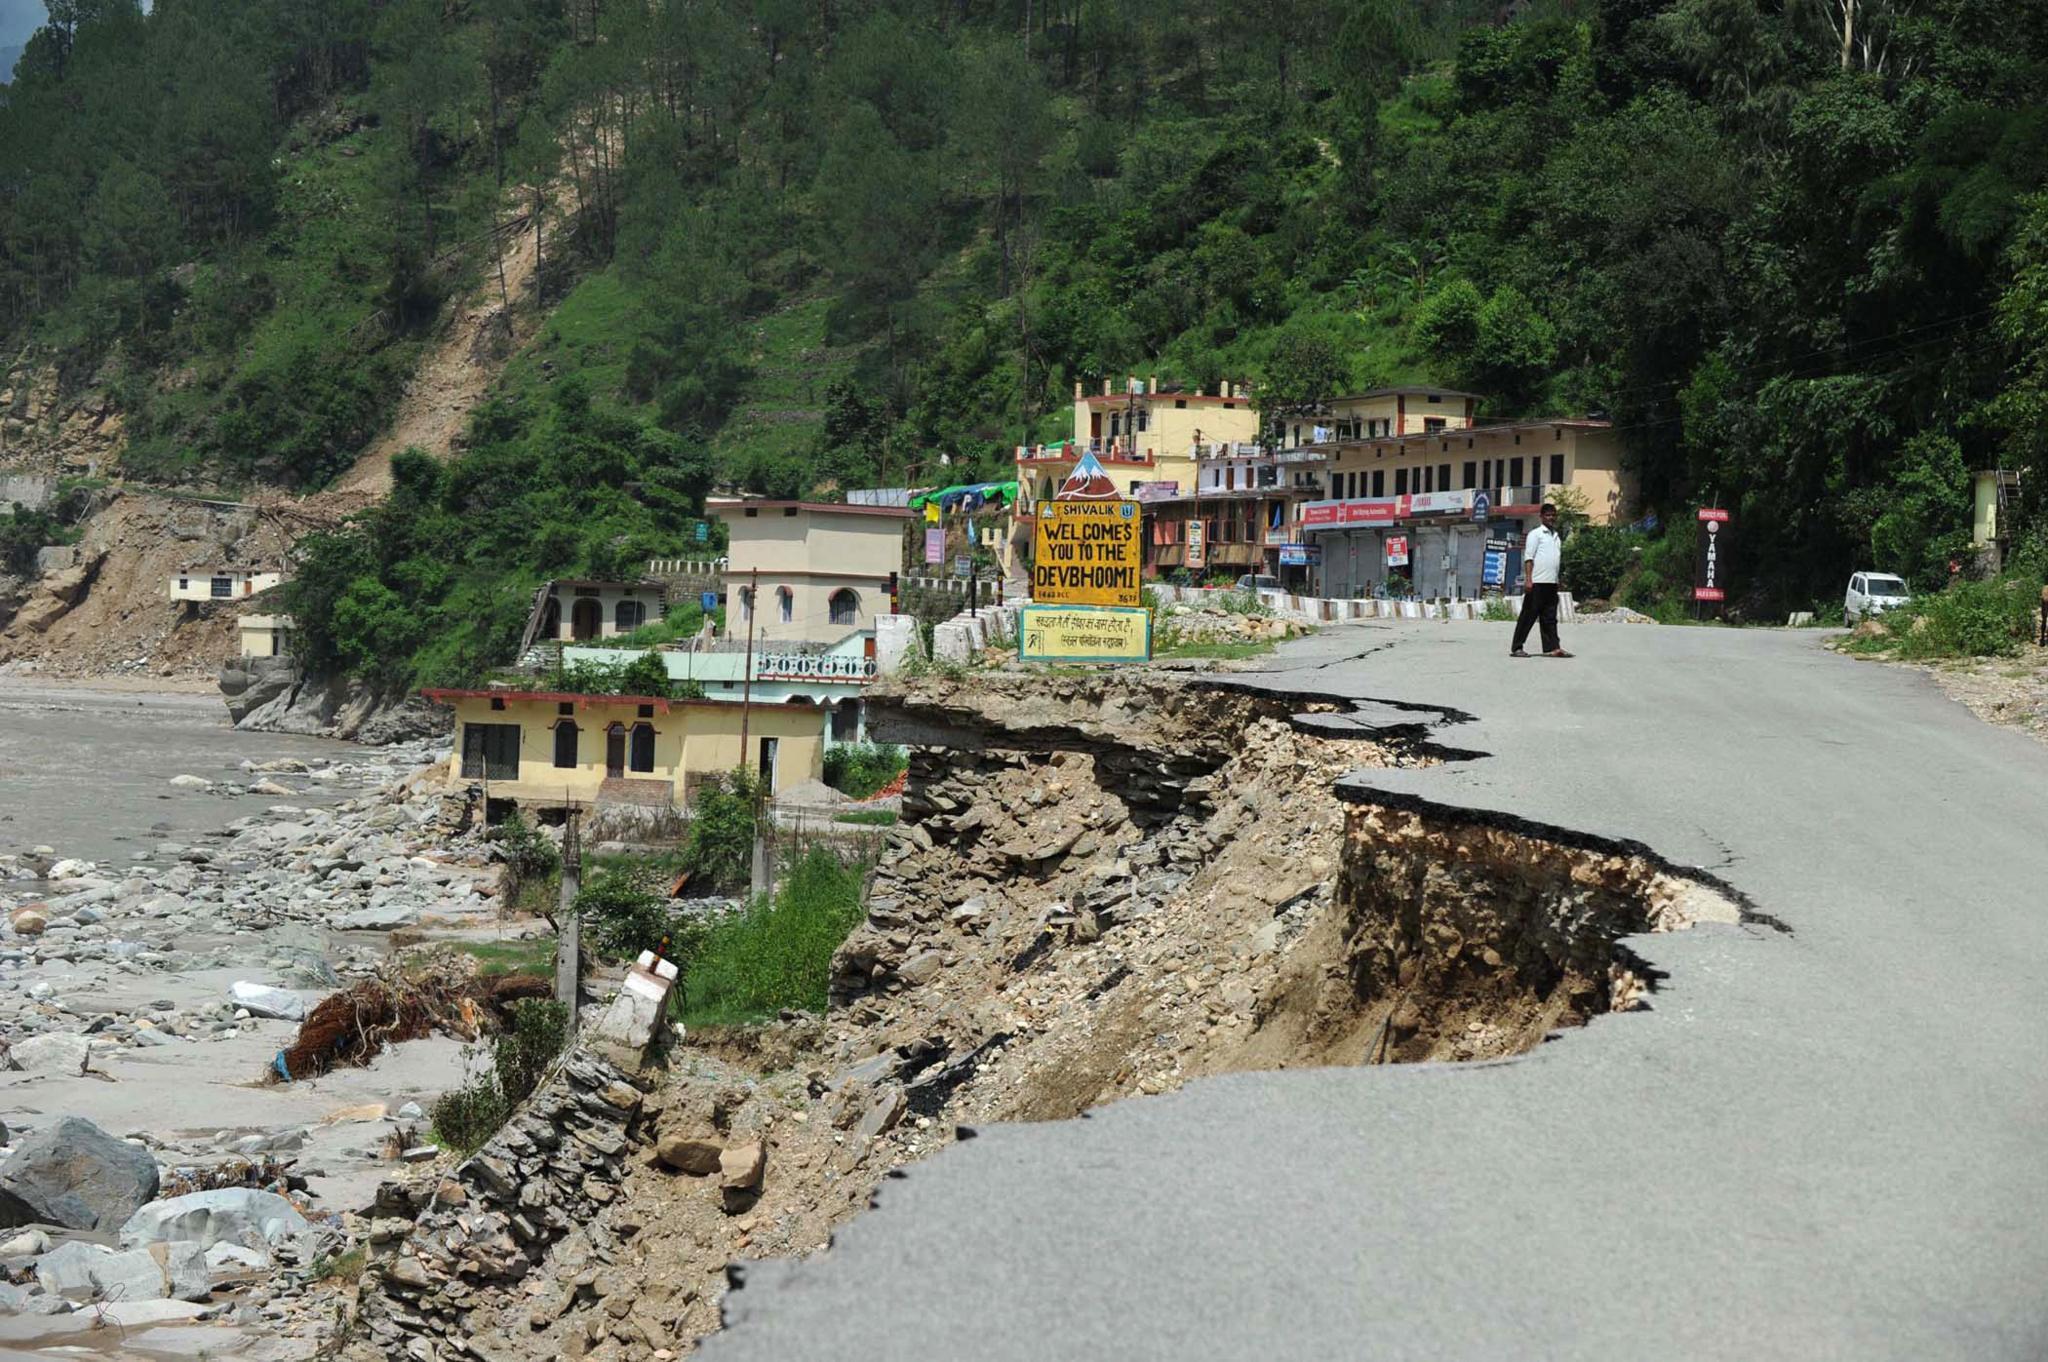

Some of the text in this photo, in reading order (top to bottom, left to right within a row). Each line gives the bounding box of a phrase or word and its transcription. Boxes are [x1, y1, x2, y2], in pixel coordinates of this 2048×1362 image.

[1063, 504, 1115, 516] SHIVALIK
[1043, 523, 1132, 541] WELCOMES
[1049, 544, 1127, 562] YOU TO THE
[1706, 533, 1717, 588] YAMAHA
[1036, 566, 1135, 589] DEVBHOOMI
